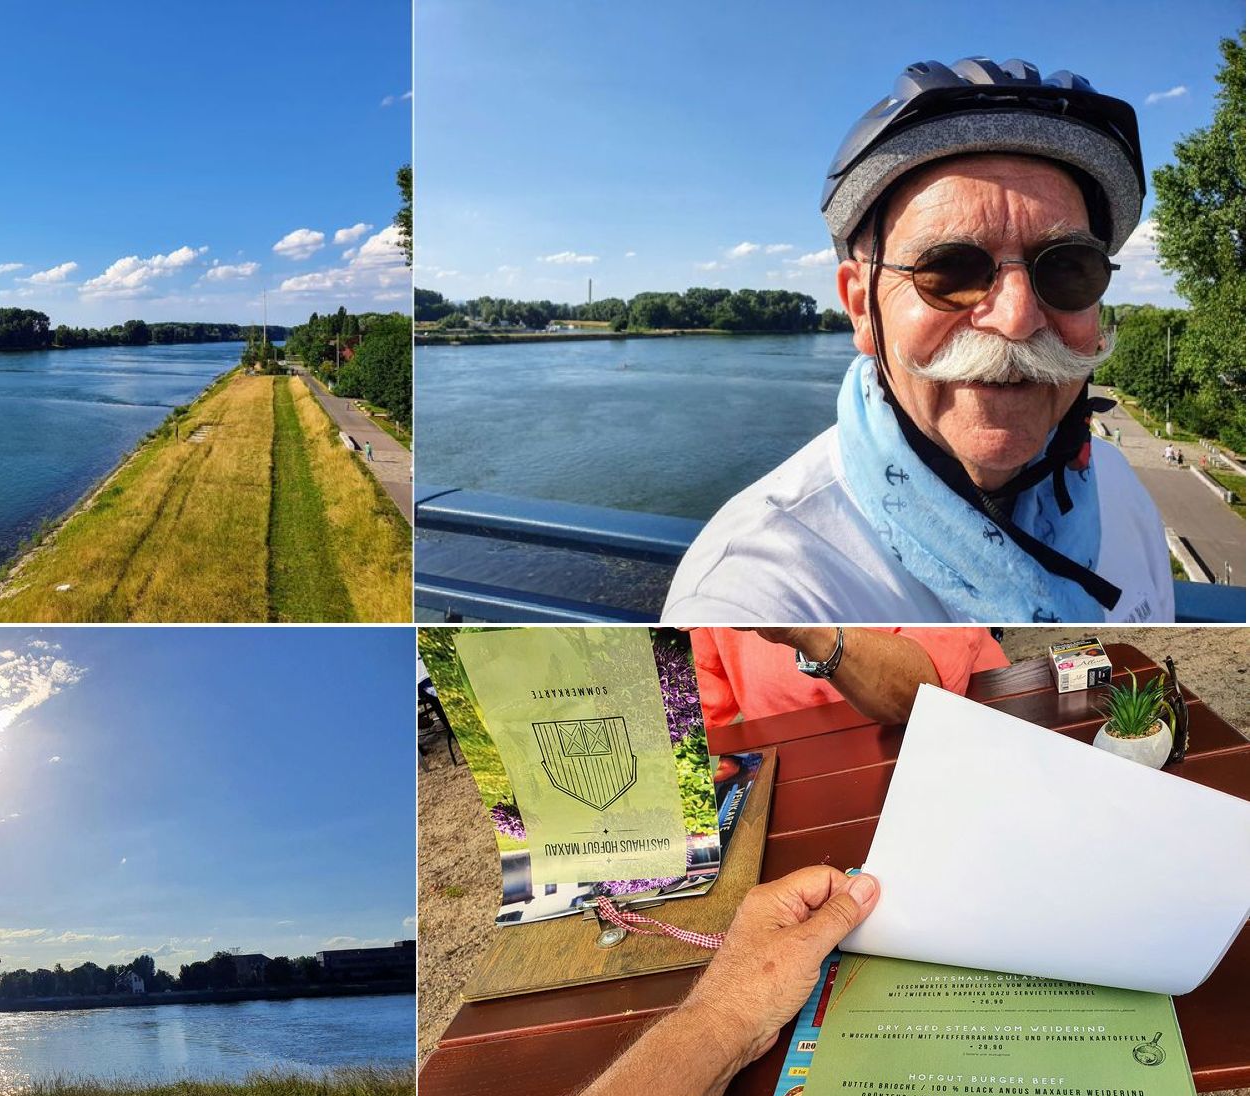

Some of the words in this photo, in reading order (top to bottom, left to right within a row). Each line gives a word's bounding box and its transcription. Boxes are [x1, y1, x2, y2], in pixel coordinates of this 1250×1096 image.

[531, 686, 608, 699] SOMMERKARTE
[544, 842, 581, 857] MAXAU
[582, 840, 618, 855] HOFGUT
[620, 838, 670, 853] GASTHAUS
[908, 1073, 963, 1082] HOFGUT
[971, 1075, 1024, 1084] BURGER
[1032, 1077, 1066, 1085] BEEF
[842, 1080, 874, 1089] BUTTER
[878, 1082, 916, 1090] BRIOCHE
[999, 1087, 1030, 1095] ANGUS
[1034, 1088, 1081, 1096] MAXAUER
[1086, 1089, 1145, 1096] WEIDERIND
